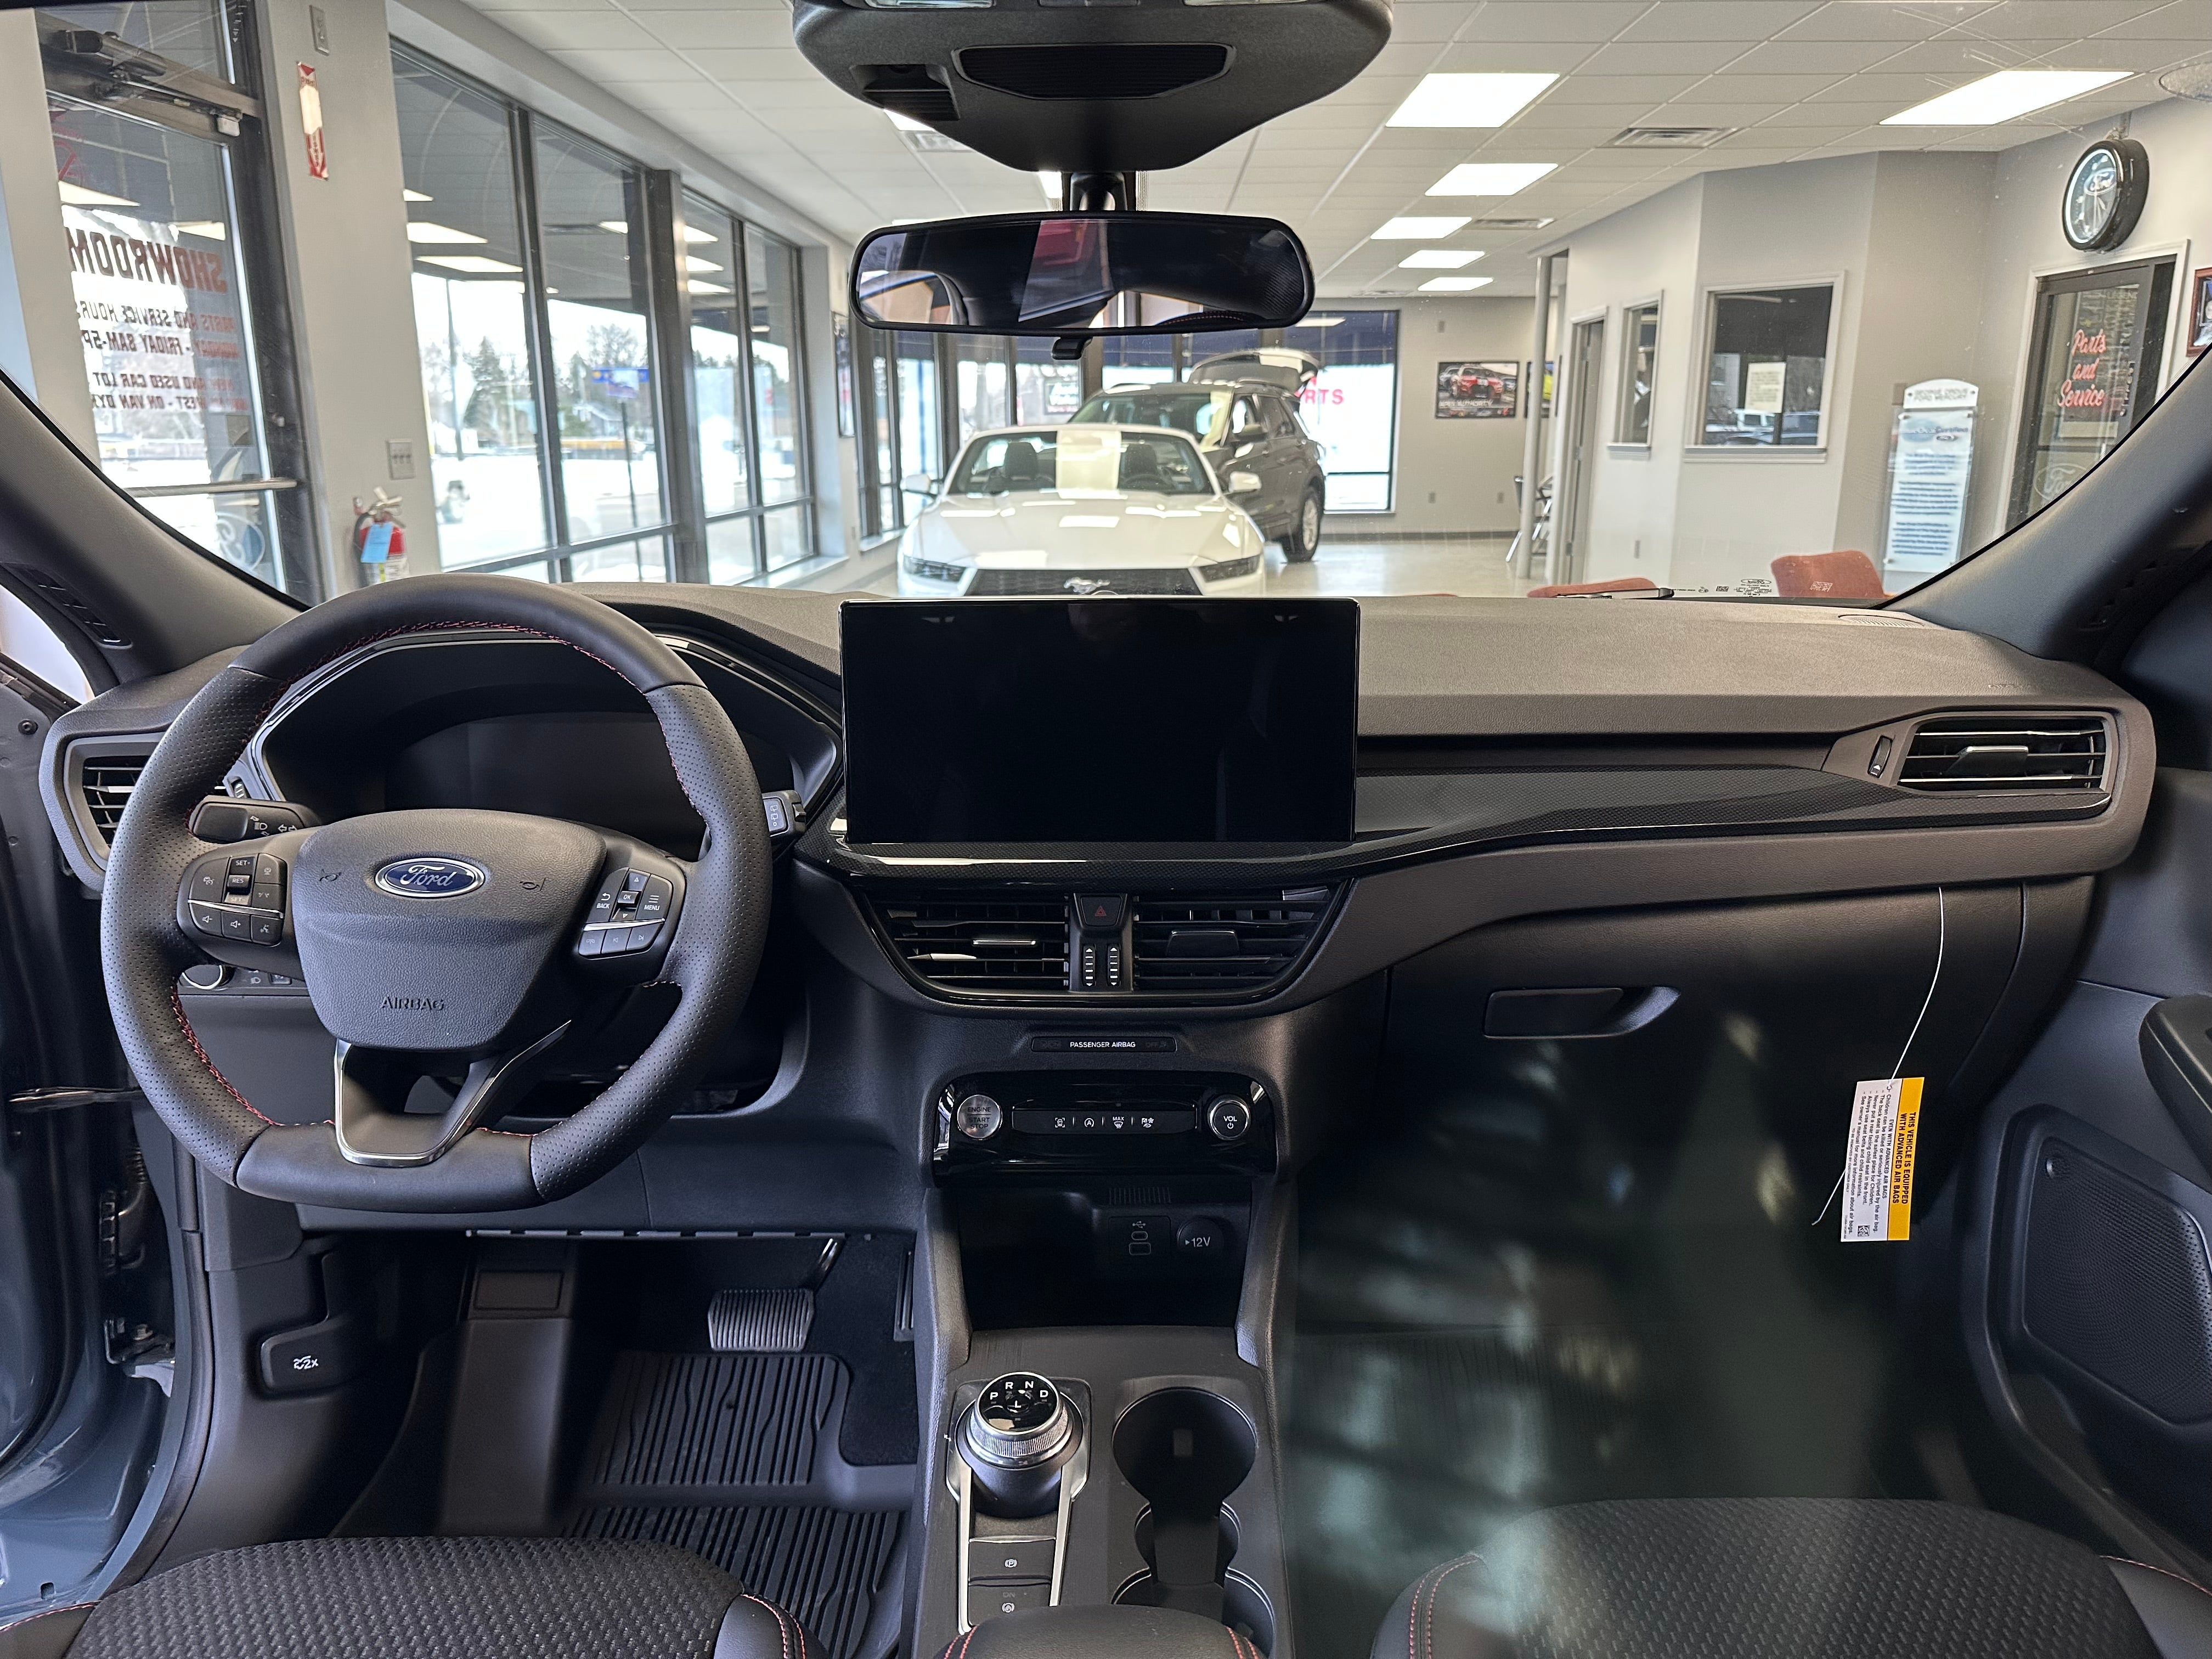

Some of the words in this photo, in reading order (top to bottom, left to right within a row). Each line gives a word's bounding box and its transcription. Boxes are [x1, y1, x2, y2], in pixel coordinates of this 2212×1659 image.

[2072, 328, 2107, 356] Parts
[2072, 358, 2100, 380] and
[1304, 388, 1344, 405] RTS
[2058, 379, 2105, 407] Service
[400, 865, 457, 887] Ford
[380, 997, 444, 1011] AIRBAG
[1895, 1132, 1905, 1169] ADVANCED
[1905, 1130, 1914, 1159] VEHICLE
[1901, 1169, 1911, 1204] EQUIPPED
[1191, 1236, 1211, 1248] 12V
[990, 1392, 998, 1400] P
[1005, 1381, 1013, 1390] R
[1014, 1400, 1022, 1408] L
